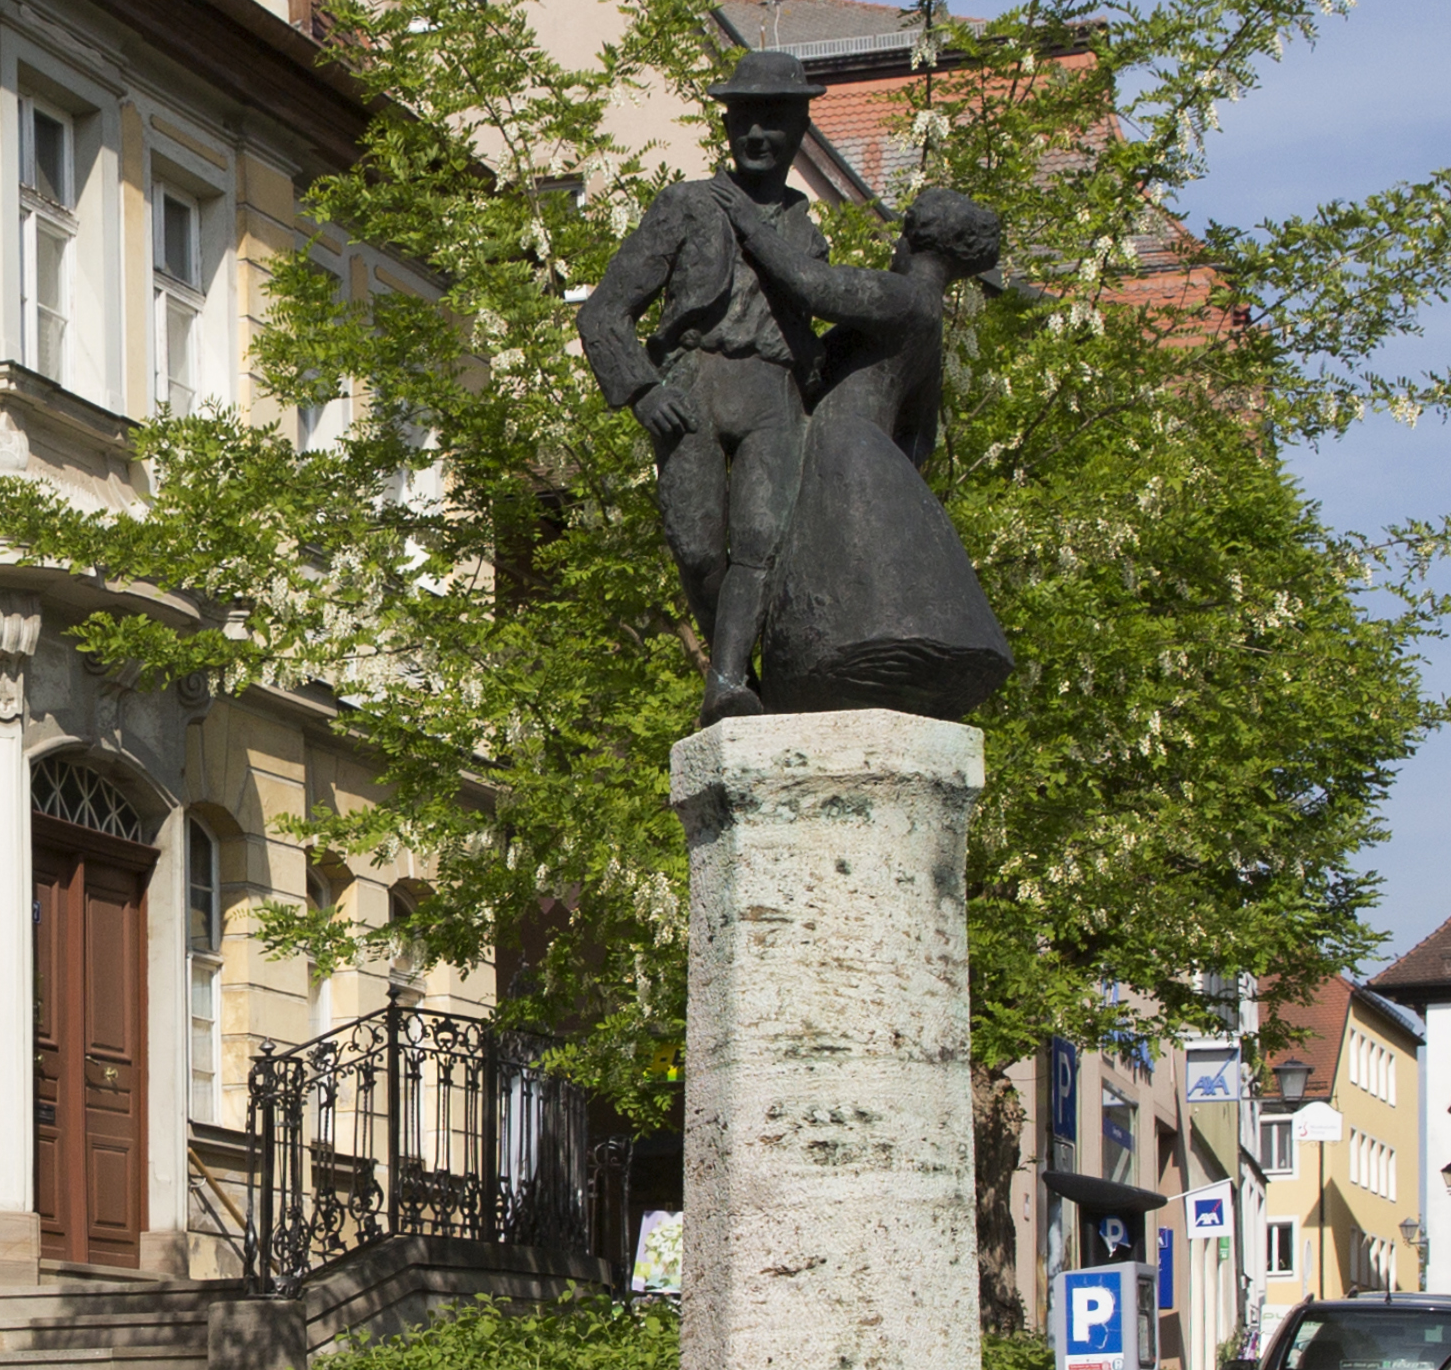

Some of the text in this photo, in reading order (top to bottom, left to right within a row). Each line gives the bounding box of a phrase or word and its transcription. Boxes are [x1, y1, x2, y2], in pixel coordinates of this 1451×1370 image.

[1187, 1075, 1231, 1097] AXA
[1195, 1212, 1221, 1227] AXA
[1072, 1286, 1116, 1343] P
